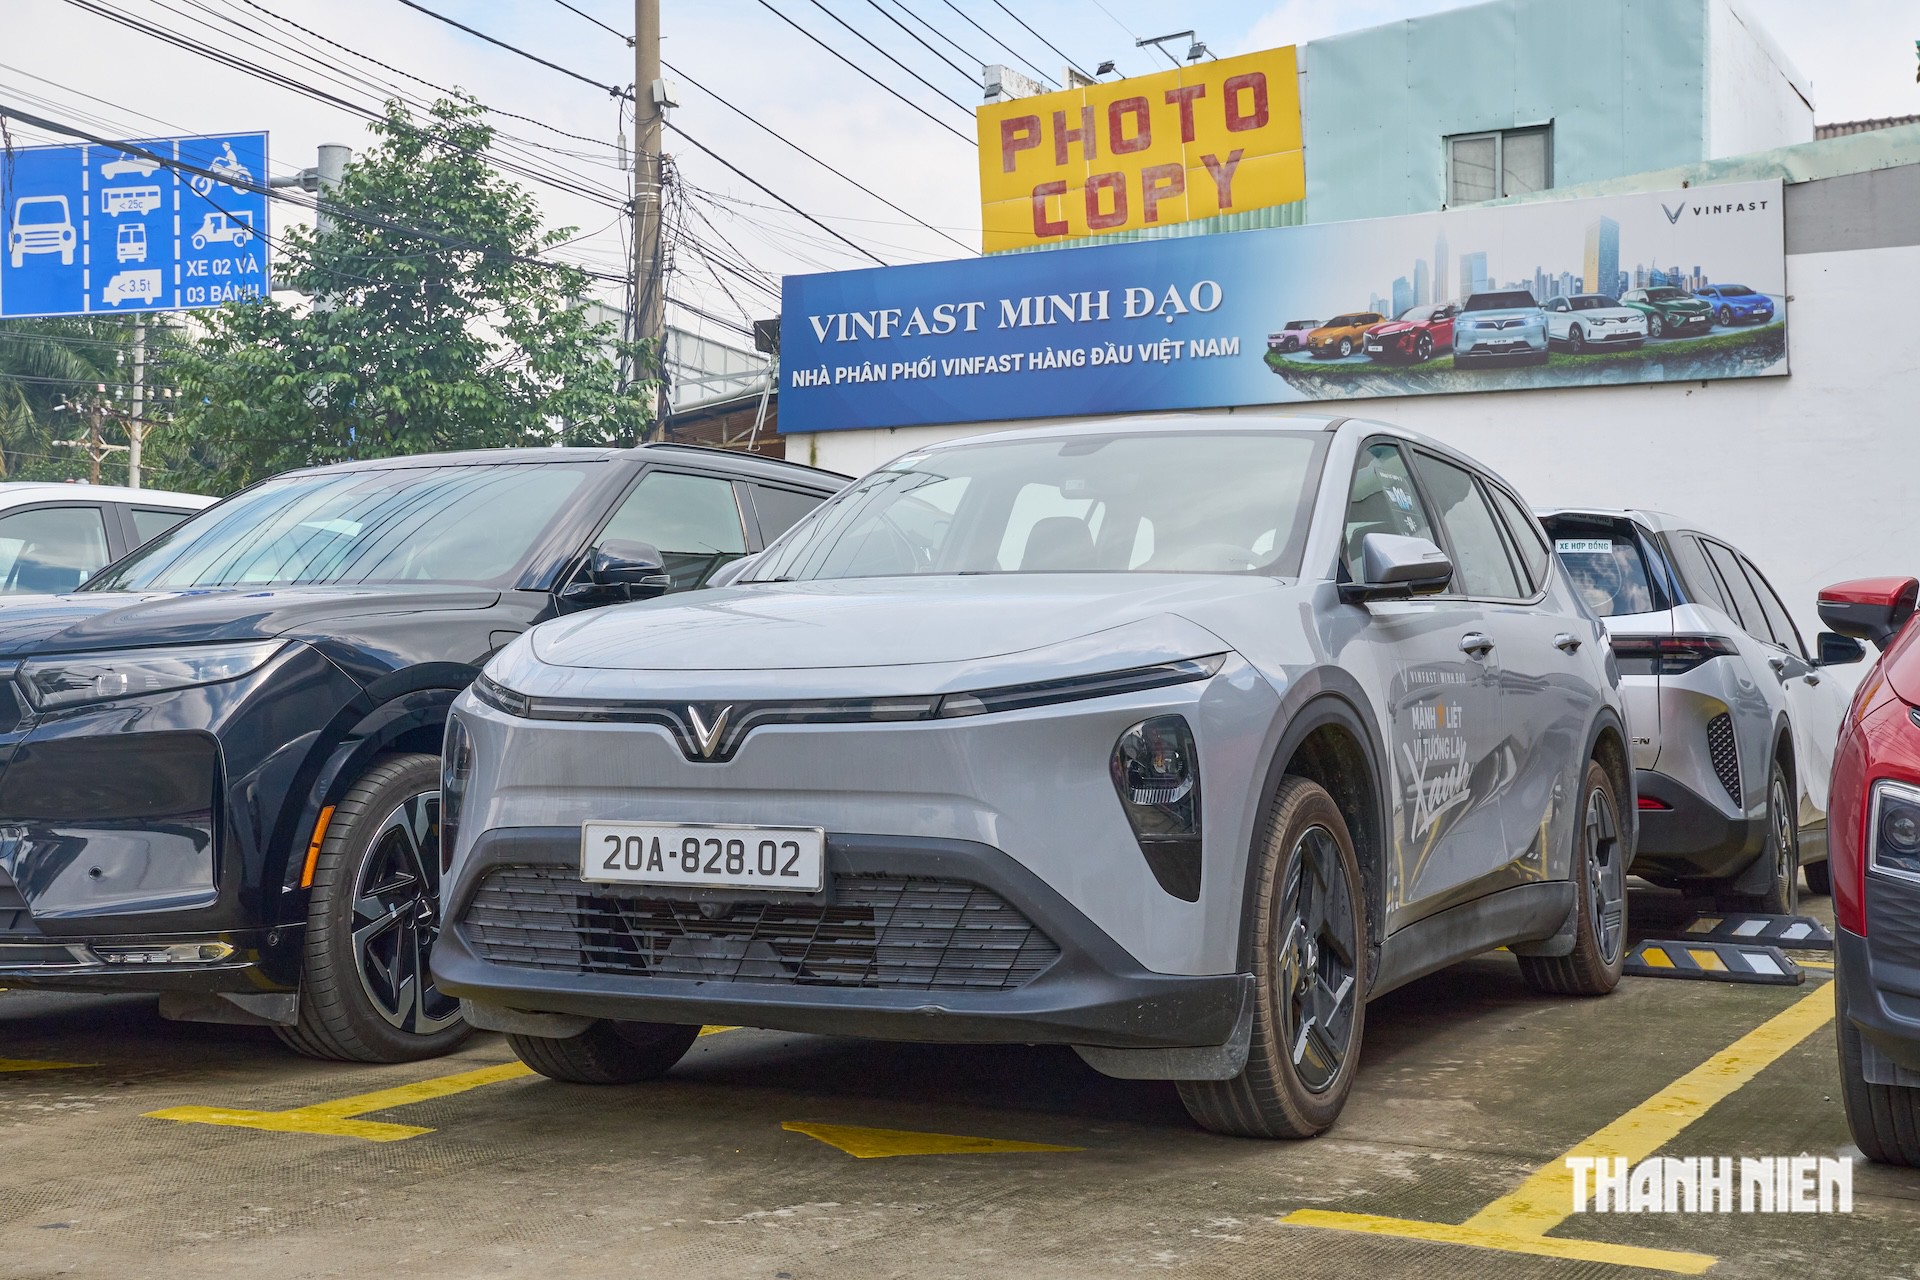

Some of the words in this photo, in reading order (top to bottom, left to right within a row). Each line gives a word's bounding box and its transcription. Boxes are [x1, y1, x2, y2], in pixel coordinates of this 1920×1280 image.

[1000, 72, 1269, 173] PHOTO
[1032, 149, 1244, 238] COPY
[1693, 201, 1768, 215] VINFAST
[186, 259, 208, 277] XE
[212, 258, 231, 276] 02
[235, 253, 259, 274] VÀ
[129, 278, 151, 292] 3.5t
[186, 287, 205, 303] 03
[210, 281, 259, 302] BÁNH
[808, 301, 986, 343] VINFAST
[997, 290, 1109, 329] MINH
[1123, 280, 1223, 324] ĐẠO
[792, 364, 831, 387] NHÀ
[835, 360, 887, 384] PHÂN
[891, 355, 936, 381] PHỐI
[941, 353, 1024, 376] VINFAST
[1029, 347, 1085, 370] HÀNG
[1090, 341, 1133, 366] ĐẦU
[1138, 338, 1184, 365] VIỆT
[1189, 336, 1239, 358] NAM
[1559, 542, 1569, 550] XE
[1410, 671, 1437, 683] VINFAST
[603, 835, 800, 877] 20A-828.02
